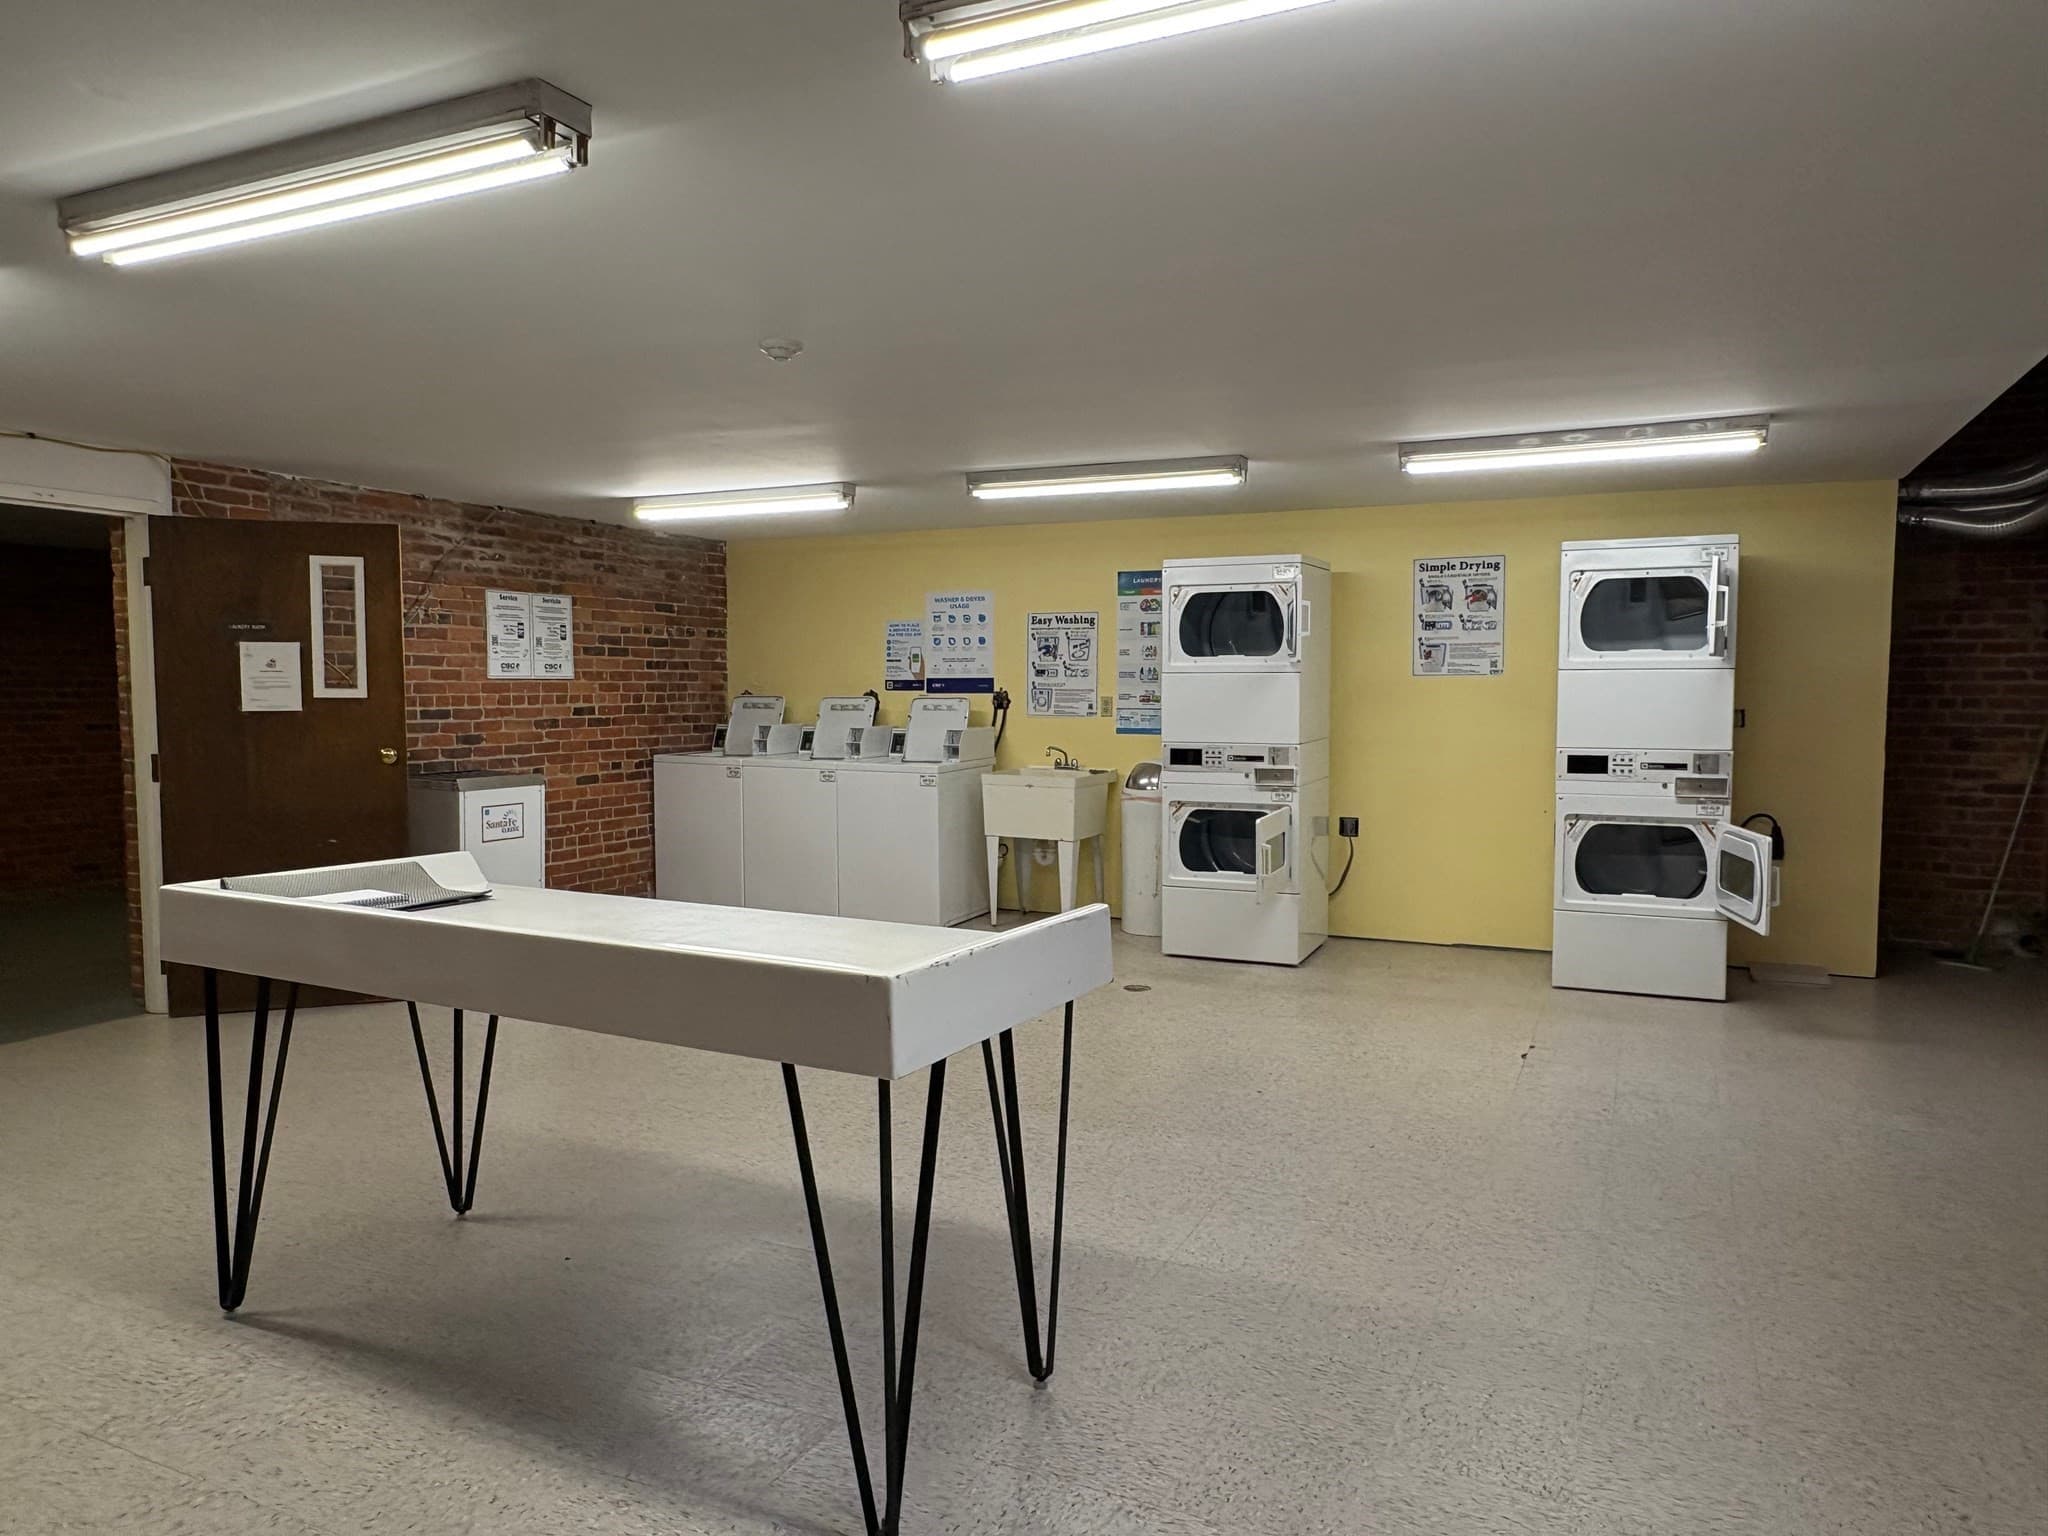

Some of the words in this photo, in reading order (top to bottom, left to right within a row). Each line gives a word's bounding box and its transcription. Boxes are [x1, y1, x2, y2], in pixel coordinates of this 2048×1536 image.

[1418, 562, 1457, 574] Simple
[1459, 560, 1501, 573] Drying
[499, 593, 518, 602] Service
[1031, 615, 1053, 627] Easy
[1055, 614, 1096, 627] Washing
[486, 820, 508, 830] Santa
[508, 817, 518, 827] Fe
